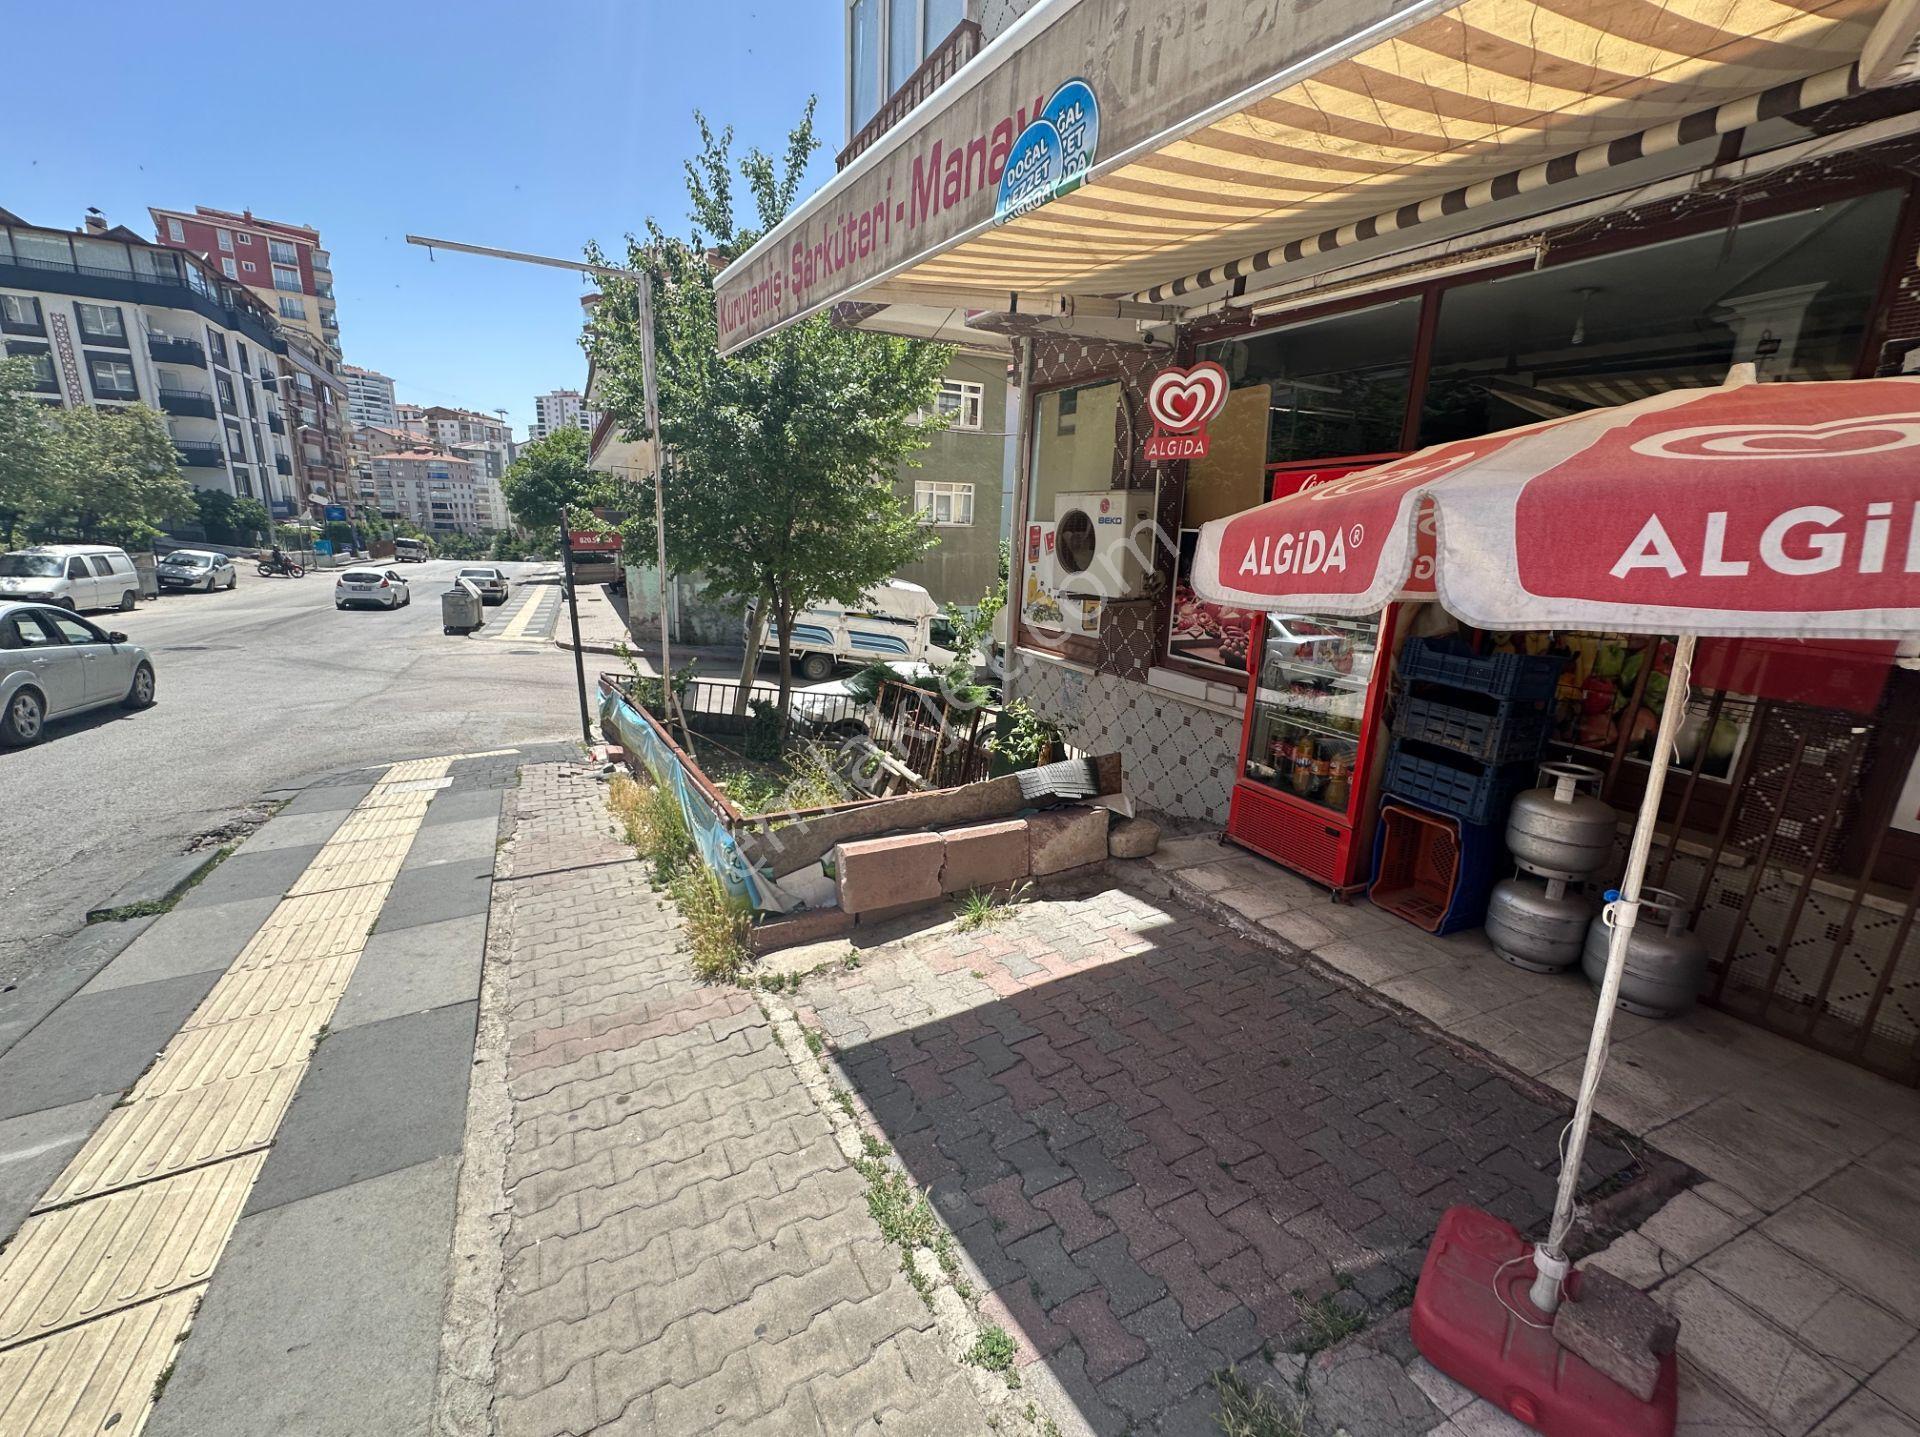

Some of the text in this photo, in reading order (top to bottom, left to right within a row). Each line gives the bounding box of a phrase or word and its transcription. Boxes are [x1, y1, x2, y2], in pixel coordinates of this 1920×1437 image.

[1005, 157, 1051, 211] LEZZET
[1007, 137, 1049, 188] DOĞAL
[1098, 516, 1122, 525] BEKO
[1608, 500, 1920, 579] ALGi
